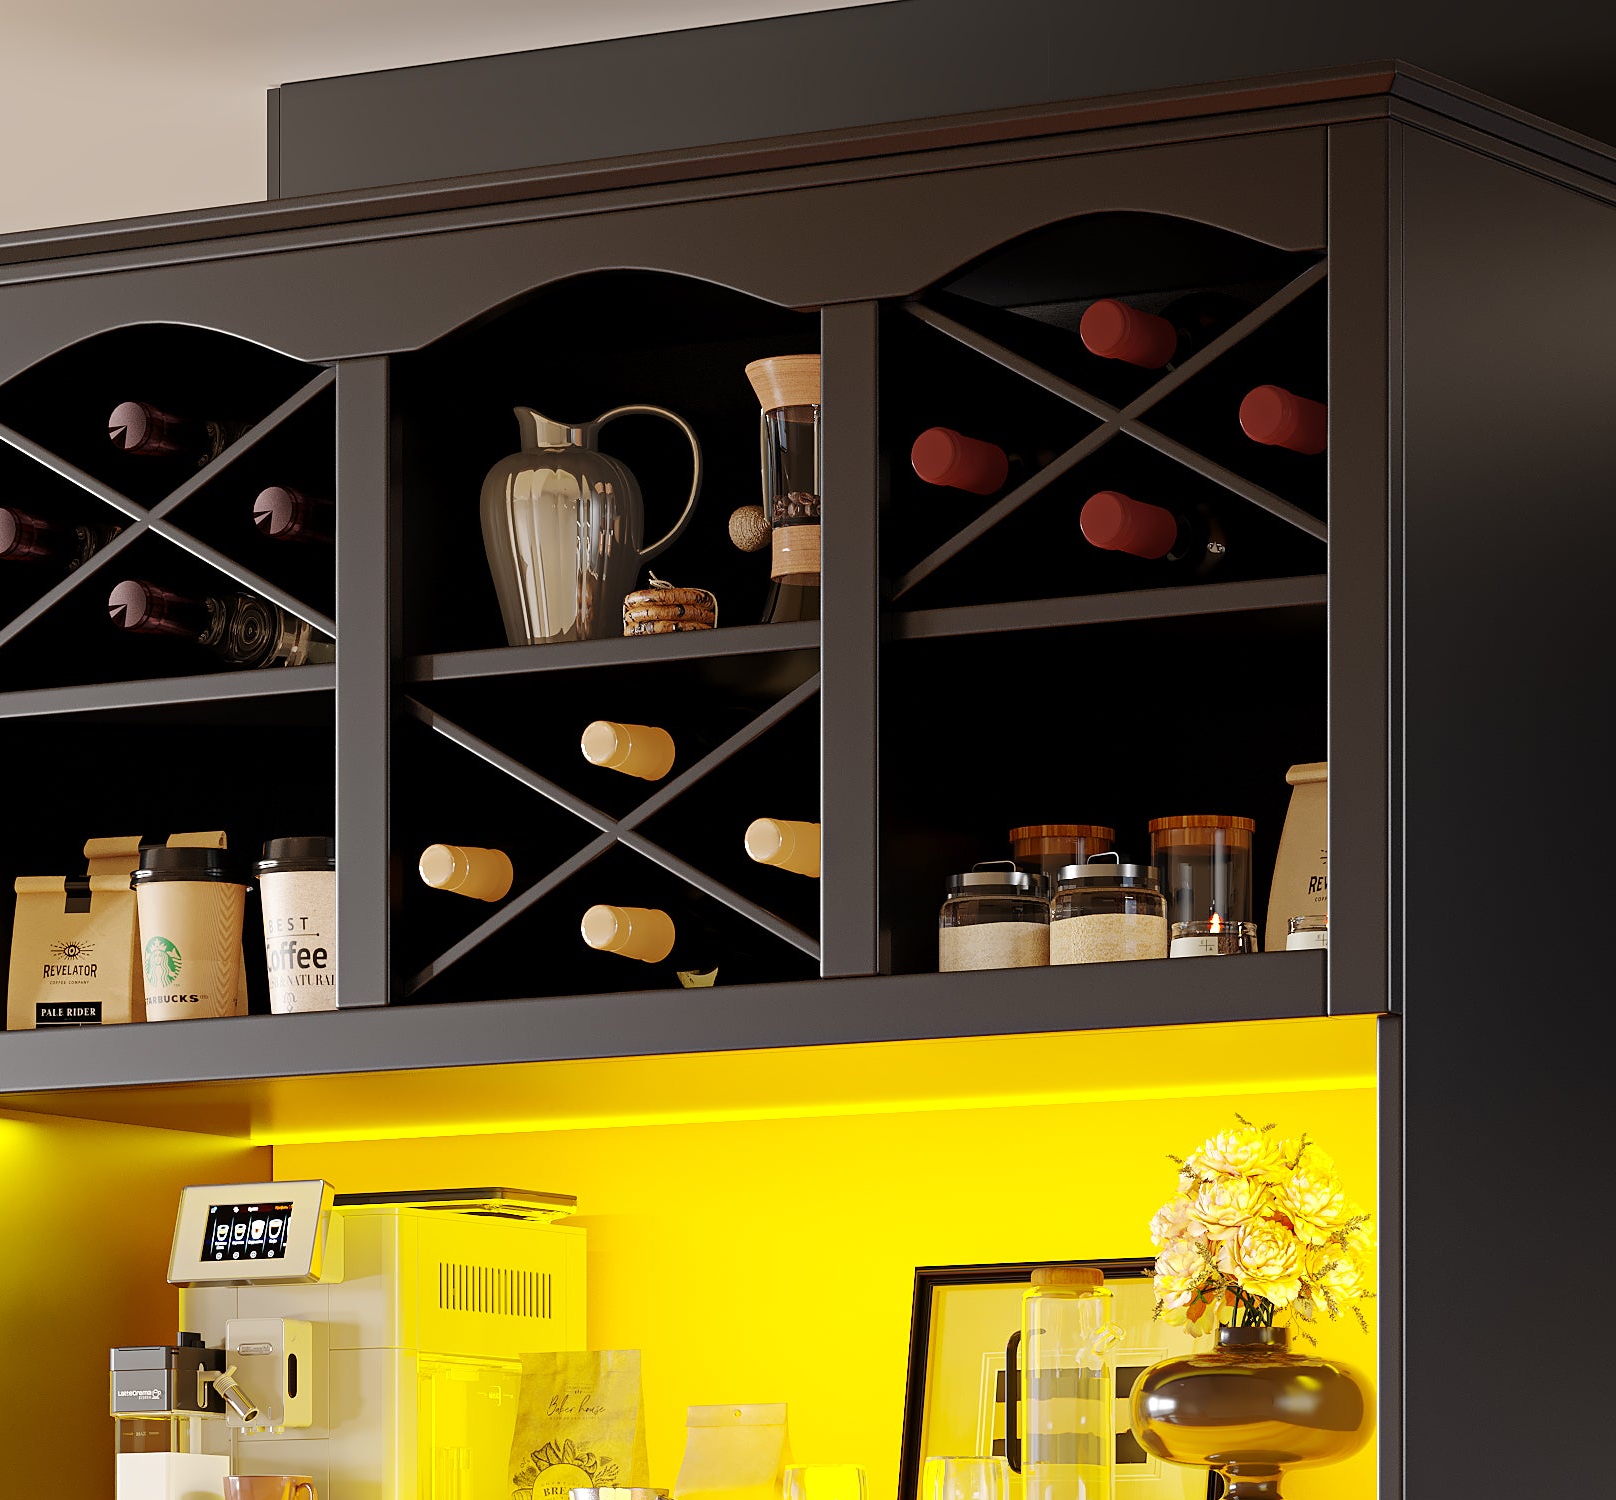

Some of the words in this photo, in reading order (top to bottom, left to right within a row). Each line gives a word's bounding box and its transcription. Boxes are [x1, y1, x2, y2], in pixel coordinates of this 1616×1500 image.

[269, 917, 308, 933] BEST
[43, 964, 98, 978] REVELATOR
[145, 994, 199, 1005] TARBUCKS
[41, 1008, 64, 1017] PALE
[67, 1008, 96, 1016] RIDER
